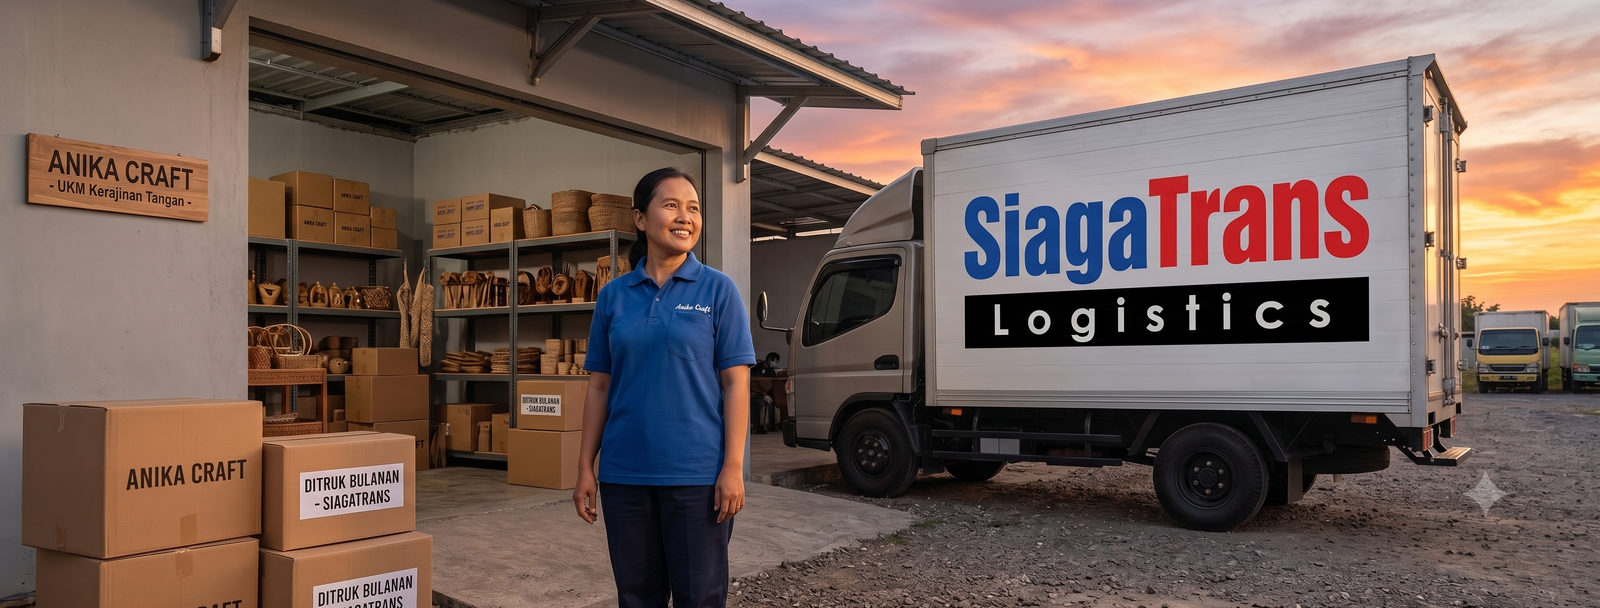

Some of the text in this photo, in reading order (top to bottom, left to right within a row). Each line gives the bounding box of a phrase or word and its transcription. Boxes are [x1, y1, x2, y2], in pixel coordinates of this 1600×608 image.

[48, 150, 193, 190] ANIKA CRAFT
[58, 180, 85, 195] UKM
[89, 184, 142, 202] Kerajinan
[146, 191, 184, 207] Tangan
[964, 175, 1370, 285] SiagaTrans
[695, 303, 711, 313] Craft
[994, 292, 1331, 343] Logistics
[539, 397, 560, 405] BULANAN
[126, 459, 246, 490] ANIKA CRAFT
[304, 469, 399, 493] DITRUK BULANAN
[323, 489, 390, 510] SIAGATRANS
[318, 575, 413, 607] DITRUK BULANAN
